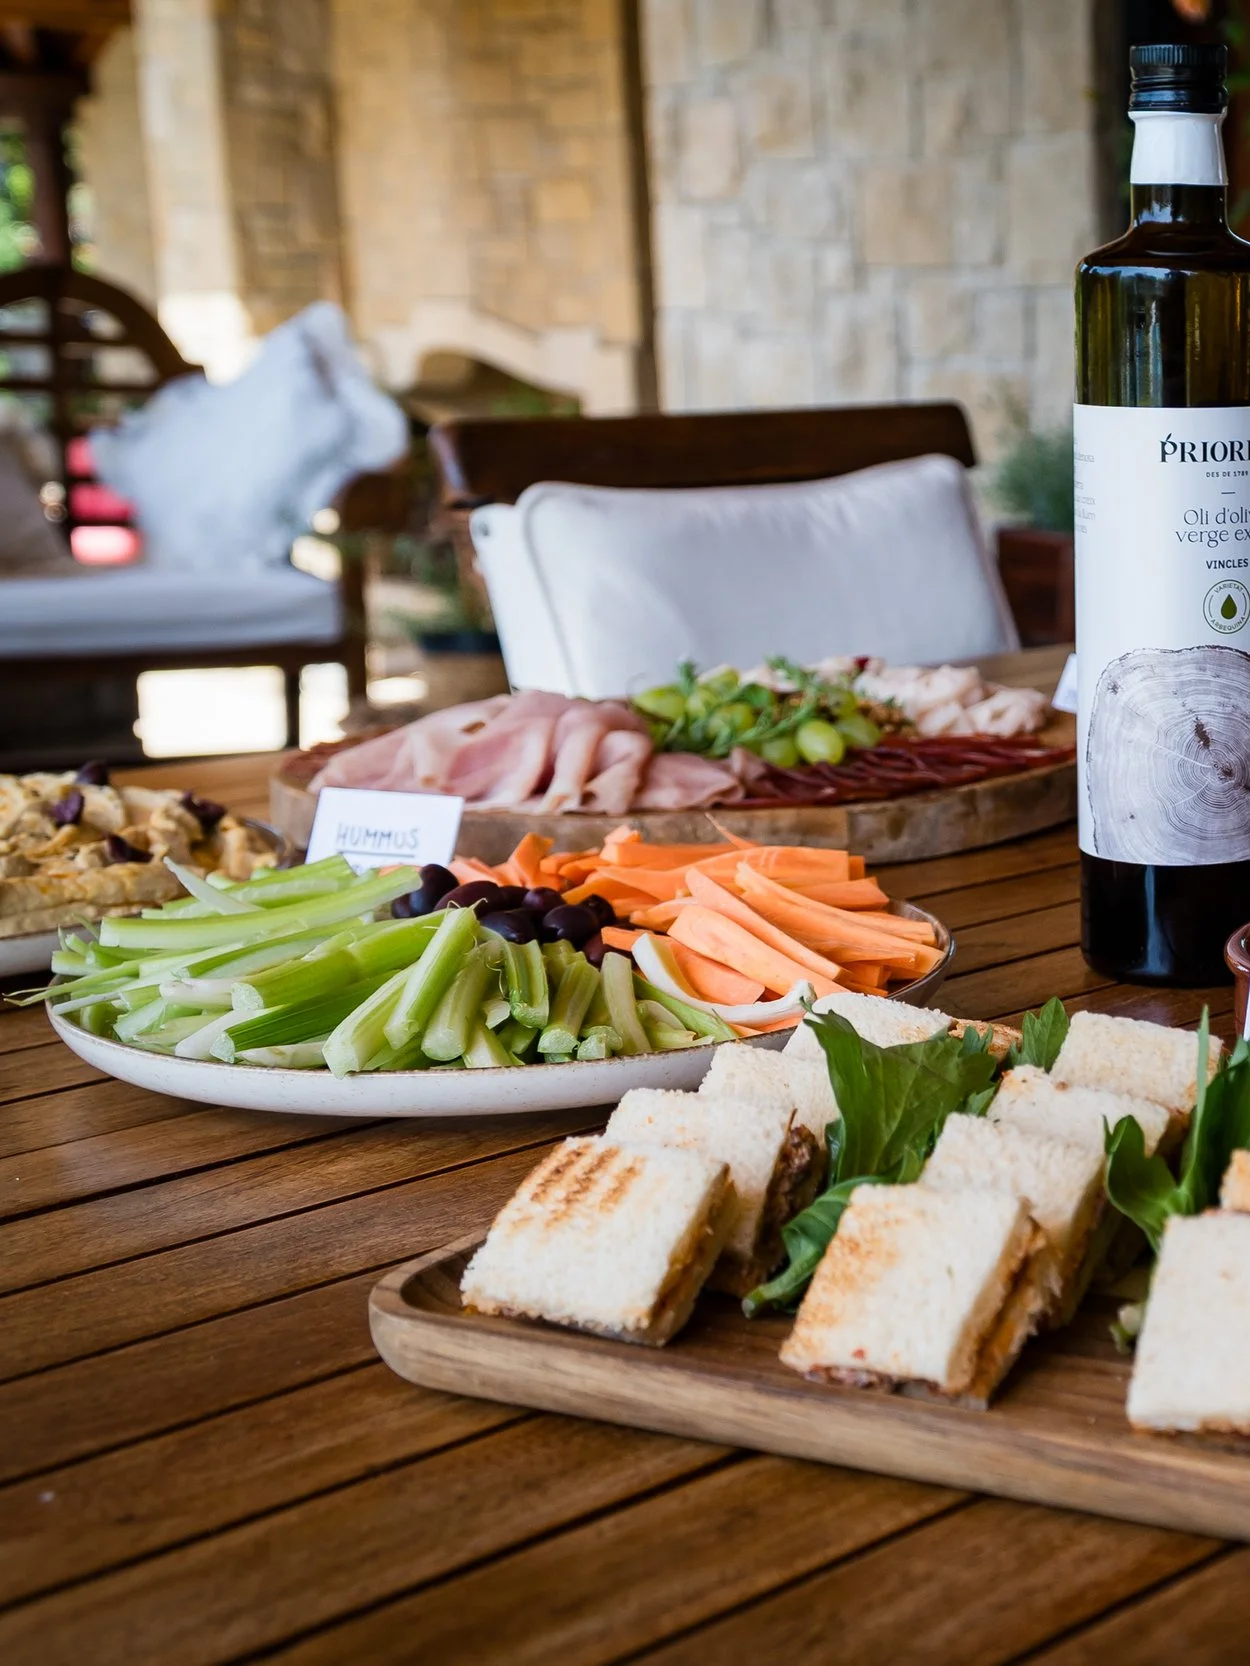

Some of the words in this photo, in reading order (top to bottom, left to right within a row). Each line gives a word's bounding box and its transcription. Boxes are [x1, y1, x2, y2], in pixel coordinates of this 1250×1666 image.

[1183, 508, 1209, 525] Oli
[1175, 529, 1230, 548] verge
[1206, 558, 1249, 570] VINCLES
[1213, 583, 1244, 594] VARIETAT
[1210, 616, 1246, 632] ARBEQUINA
[335, 821, 421, 850] HUMMUS
